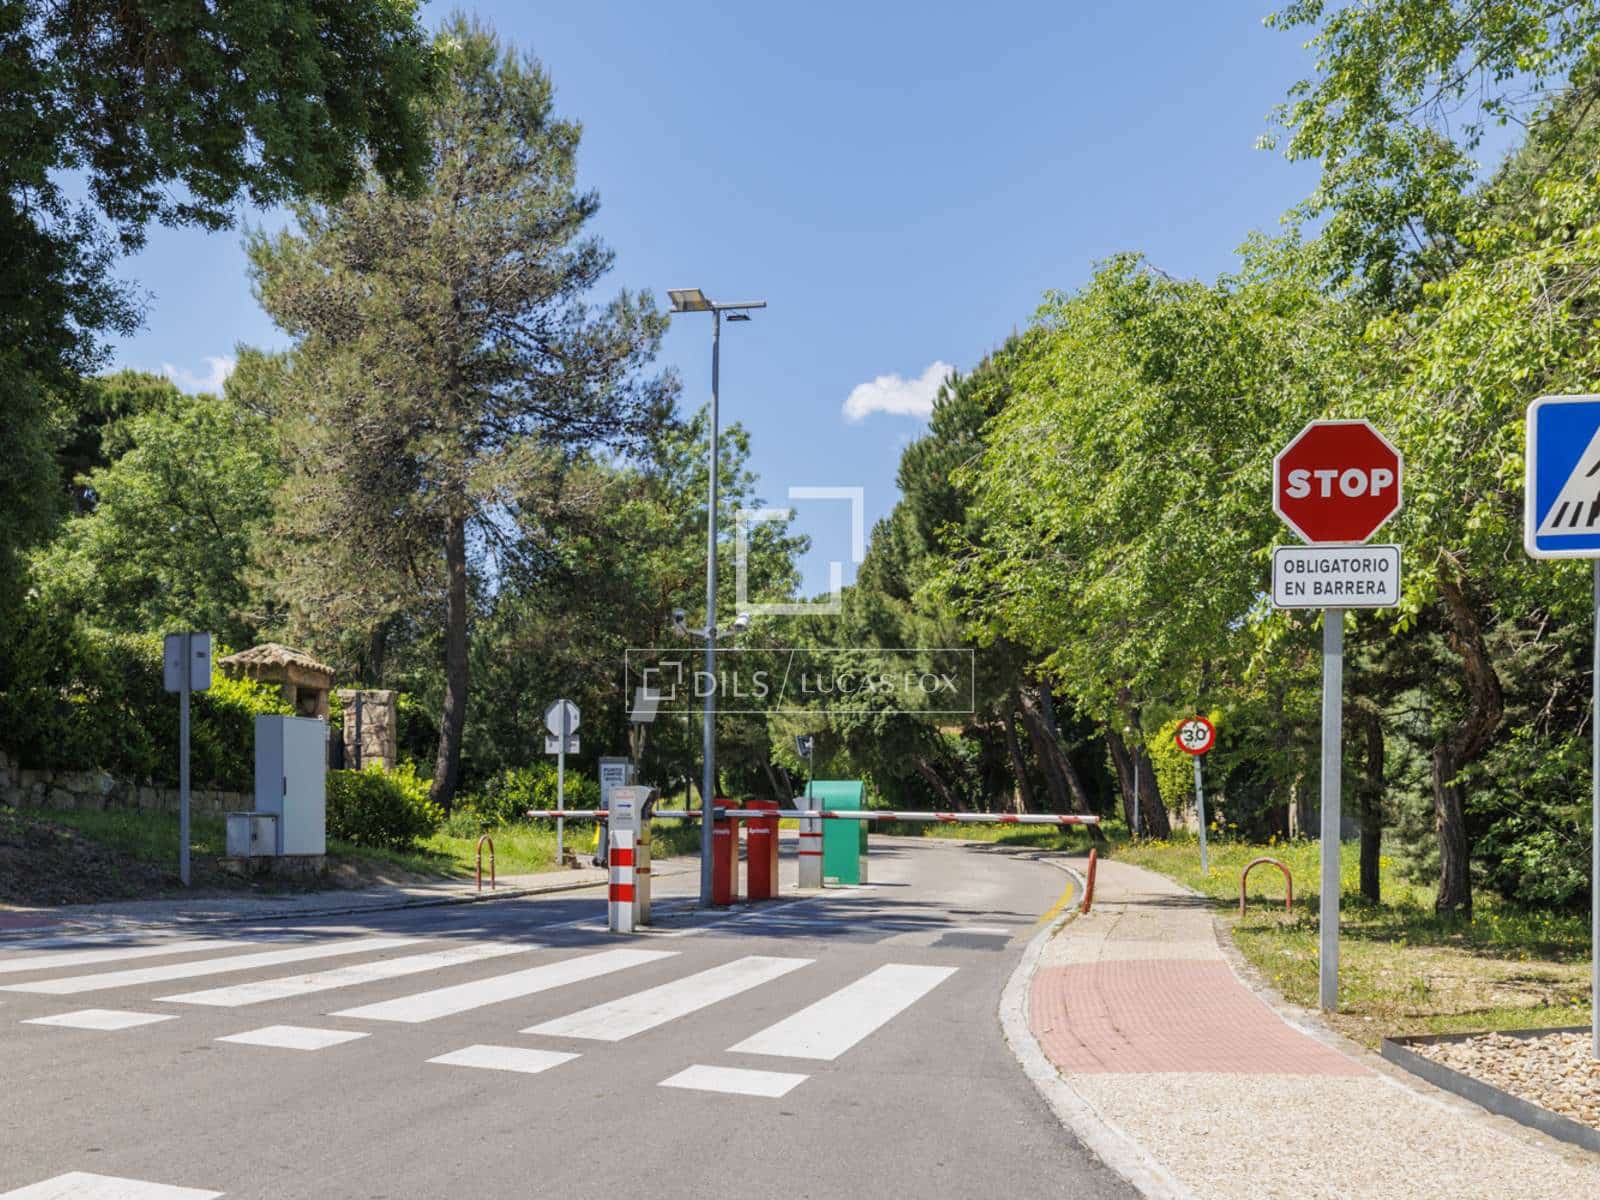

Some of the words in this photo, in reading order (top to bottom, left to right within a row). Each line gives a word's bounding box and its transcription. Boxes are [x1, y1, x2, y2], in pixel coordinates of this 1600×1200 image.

[1285, 468, 1394, 498] STOP
[1284, 558, 1389, 574] OBLIGATORIO
[1285, 581, 1305, 595] EN
[1313, 580, 1387, 595] BARRERA
[1183, 728, 1206, 742] 30
